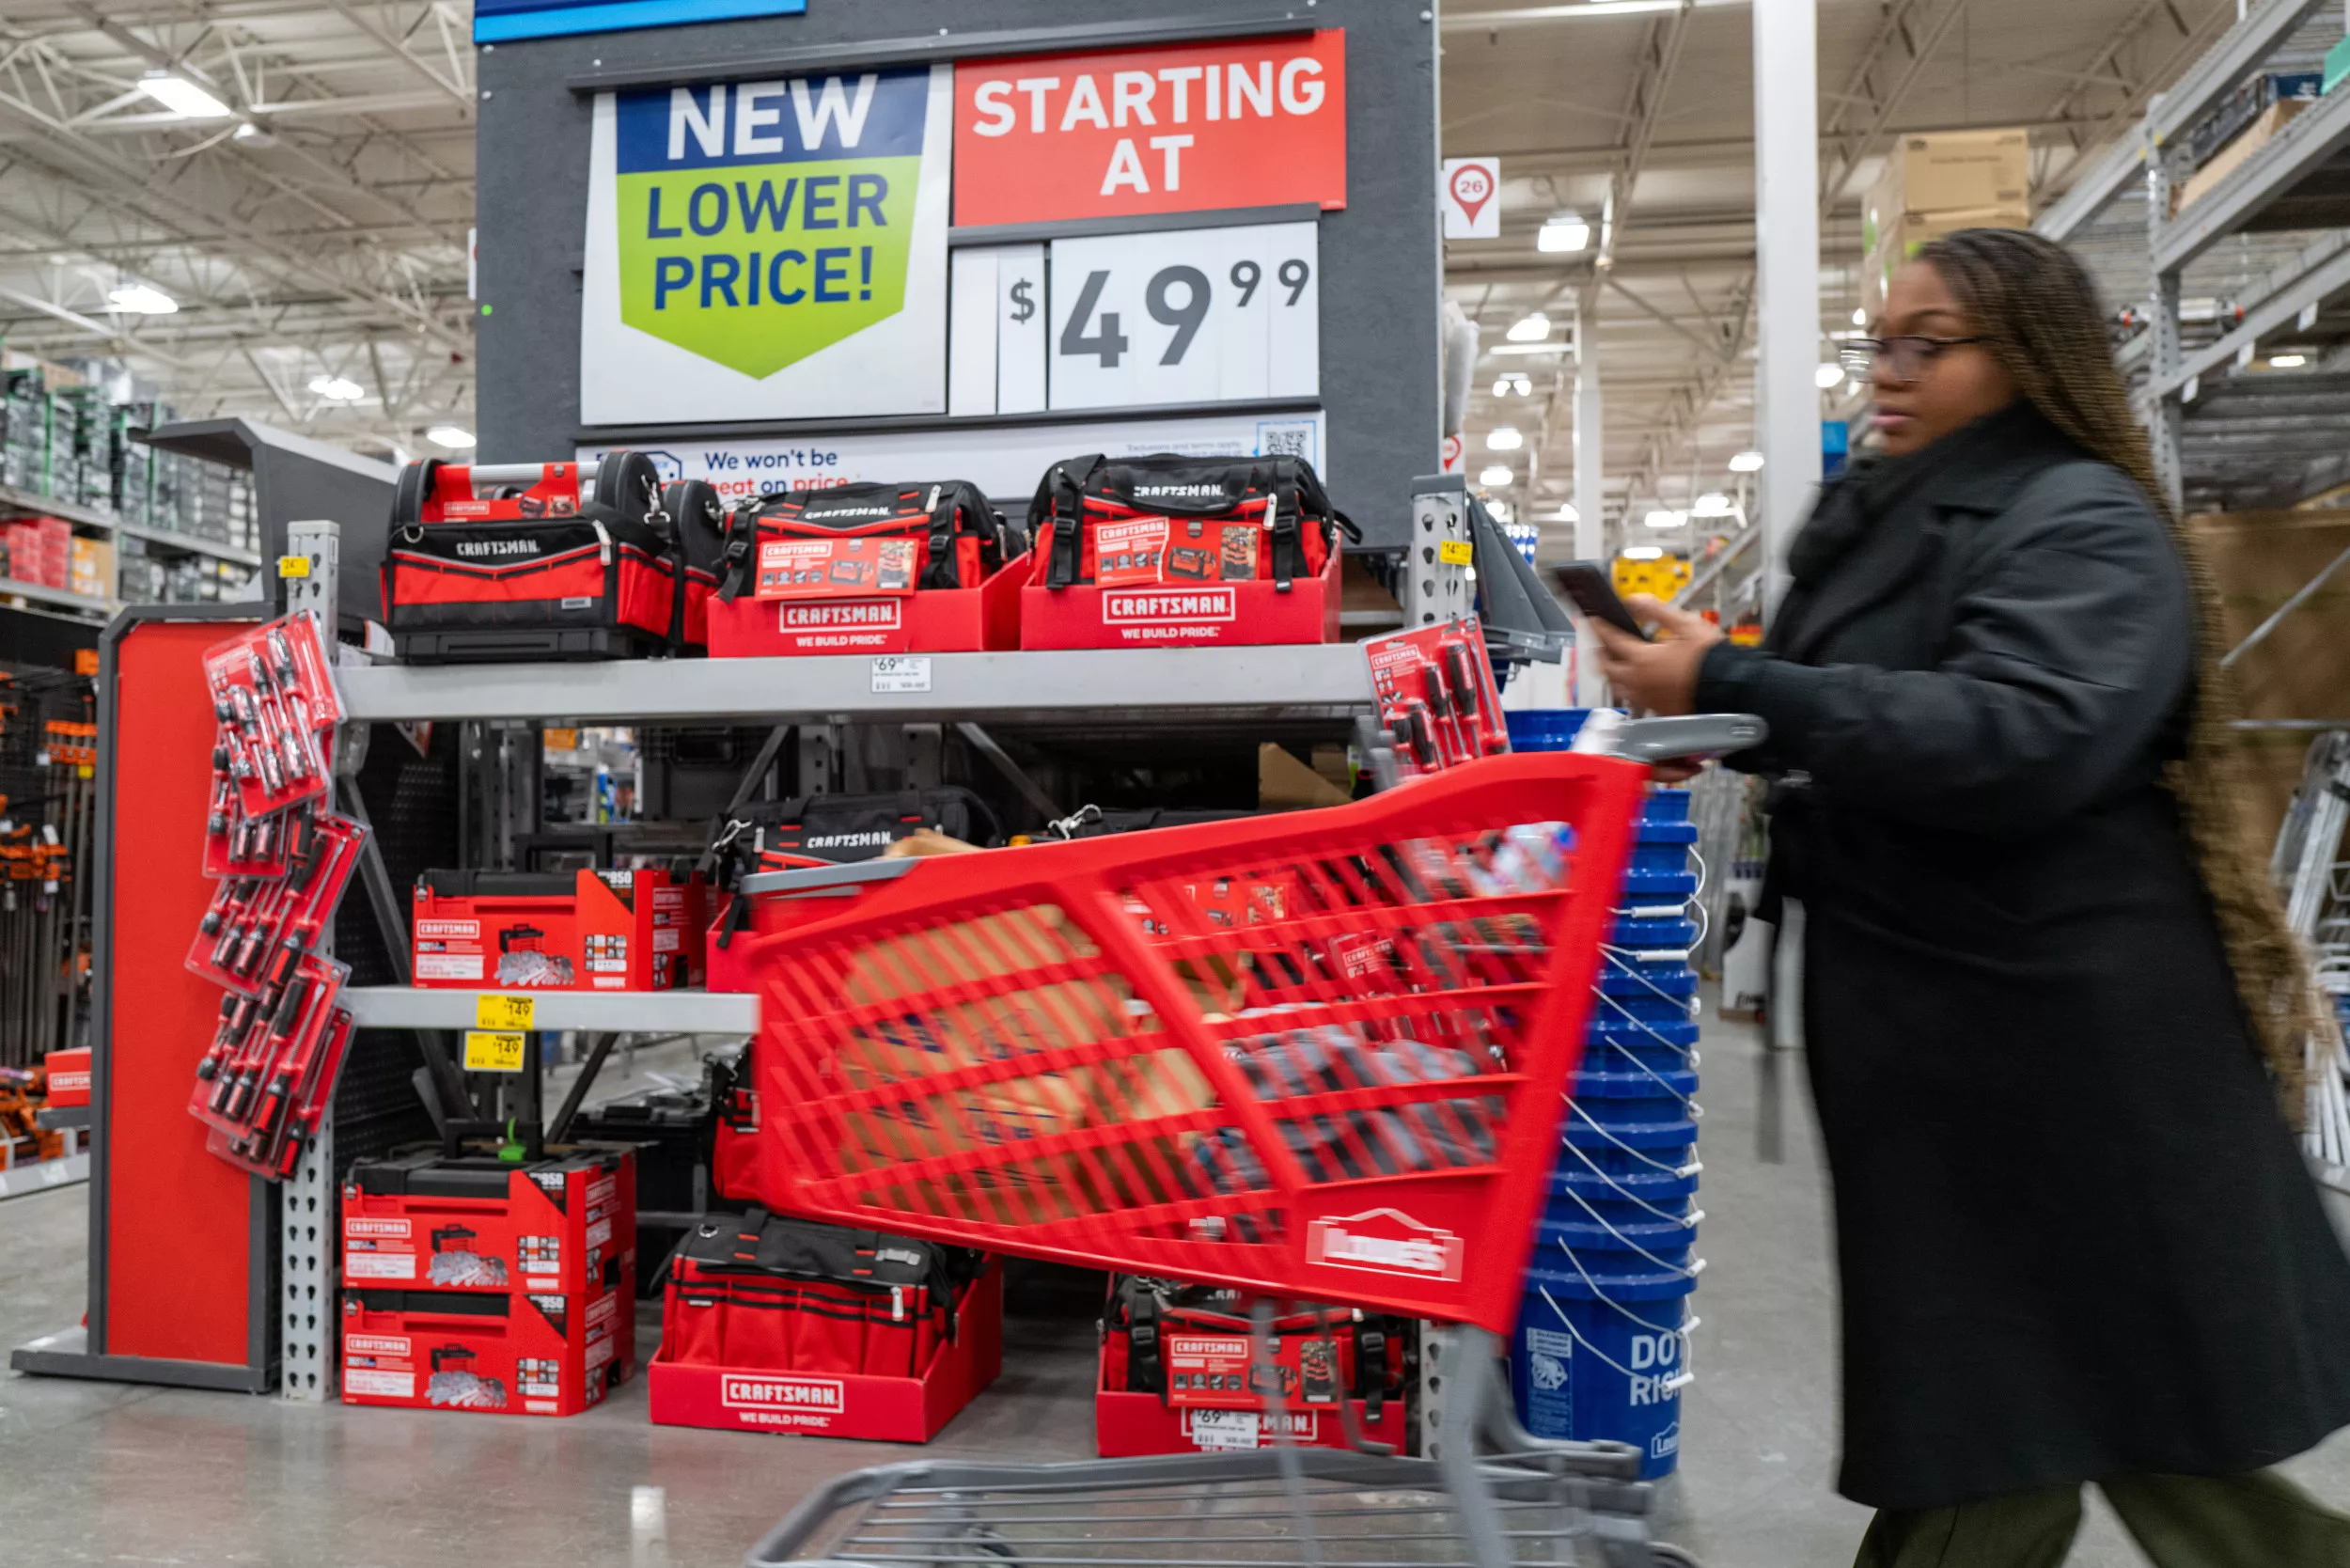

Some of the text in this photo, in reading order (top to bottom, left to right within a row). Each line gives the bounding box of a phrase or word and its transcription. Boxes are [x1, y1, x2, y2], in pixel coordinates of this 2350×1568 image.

[972, 57, 1326, 138] STARTING
[666, 72, 878, 161] NEW
[1100, 134, 1194, 196] AT
[1460, 180, 1483, 194] 26
[647, 173, 889, 240] LOWER
[653, 245, 874, 311] PRICE!
[705, 447, 838, 470] We won't be
[760, 479, 787, 494] on
[804, 507, 890, 520] CRAFTSMAN
[456, 540, 540, 557] CRAFTSMAN
[787, 604, 894, 625] CRAFTSMAN
[1111, 595, 1228, 617] CRAFTSMAN
[796, 636, 814, 648] WE
[815, 635, 848, 647] BUILD
[1121, 629, 1141, 639] WE
[1142, 628, 1178, 639] BUILD
[807, 831, 892, 849] CRAFTSMAN
[1176, 1341, 1244, 1354] CRAFTSMAN
[1632, 1333, 1676, 1370] DO
[729, 1382, 838, 1405] CRAFTSMAN
[1630, 1368, 1681, 1406] RIG
[759, 1412, 791, 1425] BUILD
